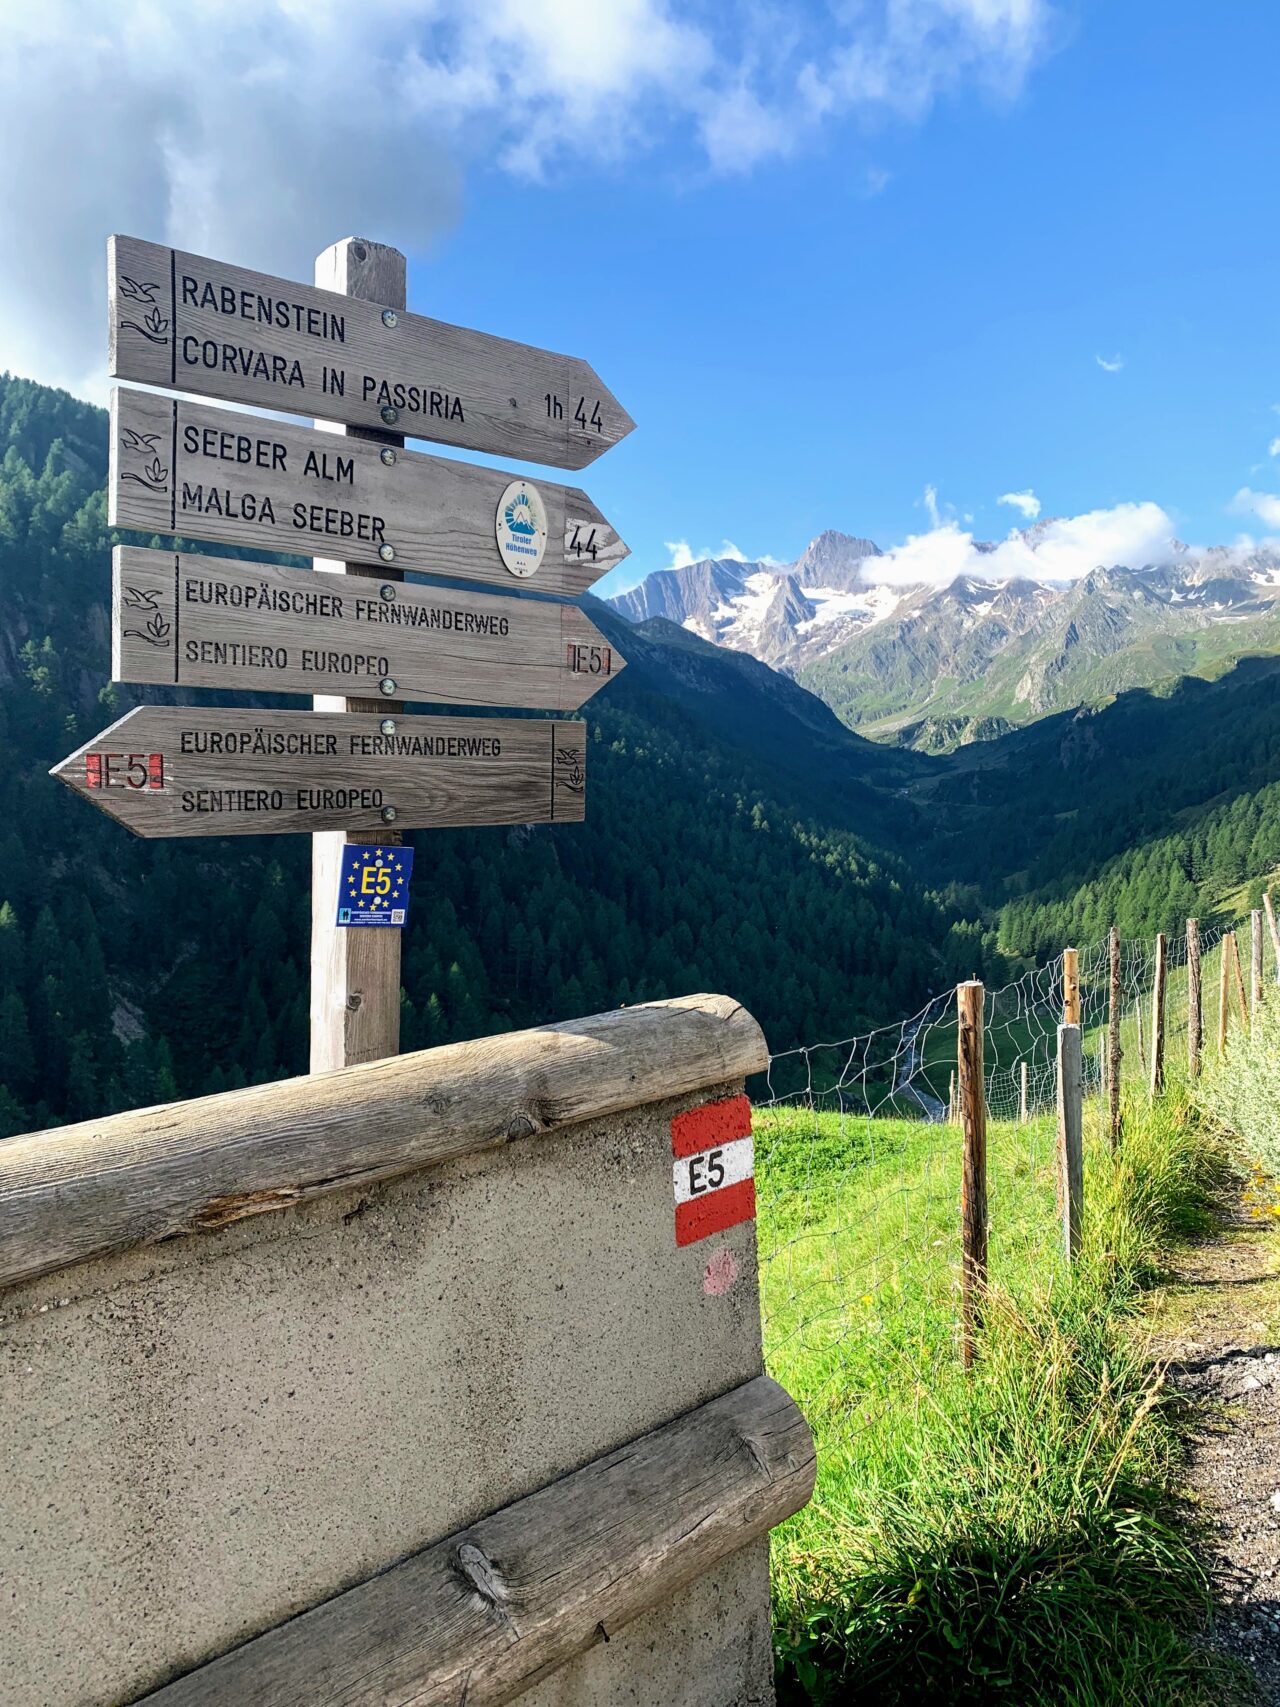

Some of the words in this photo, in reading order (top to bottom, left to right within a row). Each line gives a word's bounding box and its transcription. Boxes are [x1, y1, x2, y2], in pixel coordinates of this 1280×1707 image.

[182, 277, 346, 343] RABENSTEIN
[182, 336, 305, 388] CORVARA
[322, 367, 345, 397] IN
[362, 376, 465, 422] PASSIRIA
[544, 394, 563, 420] 1h
[574, 397, 603, 432] 44
[183, 426, 287, 471] SEEBER
[304, 451, 355, 484] ALM
[182, 483, 275, 523] MALGA
[292, 503, 386, 542] SEEBER
[505, 543, 538, 556] Höhenweg
[512, 534, 532, 544] Tiroler
[570, 525, 598, 560] 44
[185, 579, 343, 618] EUROPÄISCHER
[356, 599, 509, 636] FERNWANDERWEG
[185, 639, 287, 669] SENTIERO
[301, 650, 389, 676] EUROPEO
[181, 728, 337, 755] EUROPÄISCHER
[350, 734, 501, 757] FERNWANDERWEG
[182, 789, 283, 813] SENTIERO
[296, 788, 383, 809] EUROPEO
[361, 866, 391, 895] E5
[689, 1150, 724, 1195] E5
